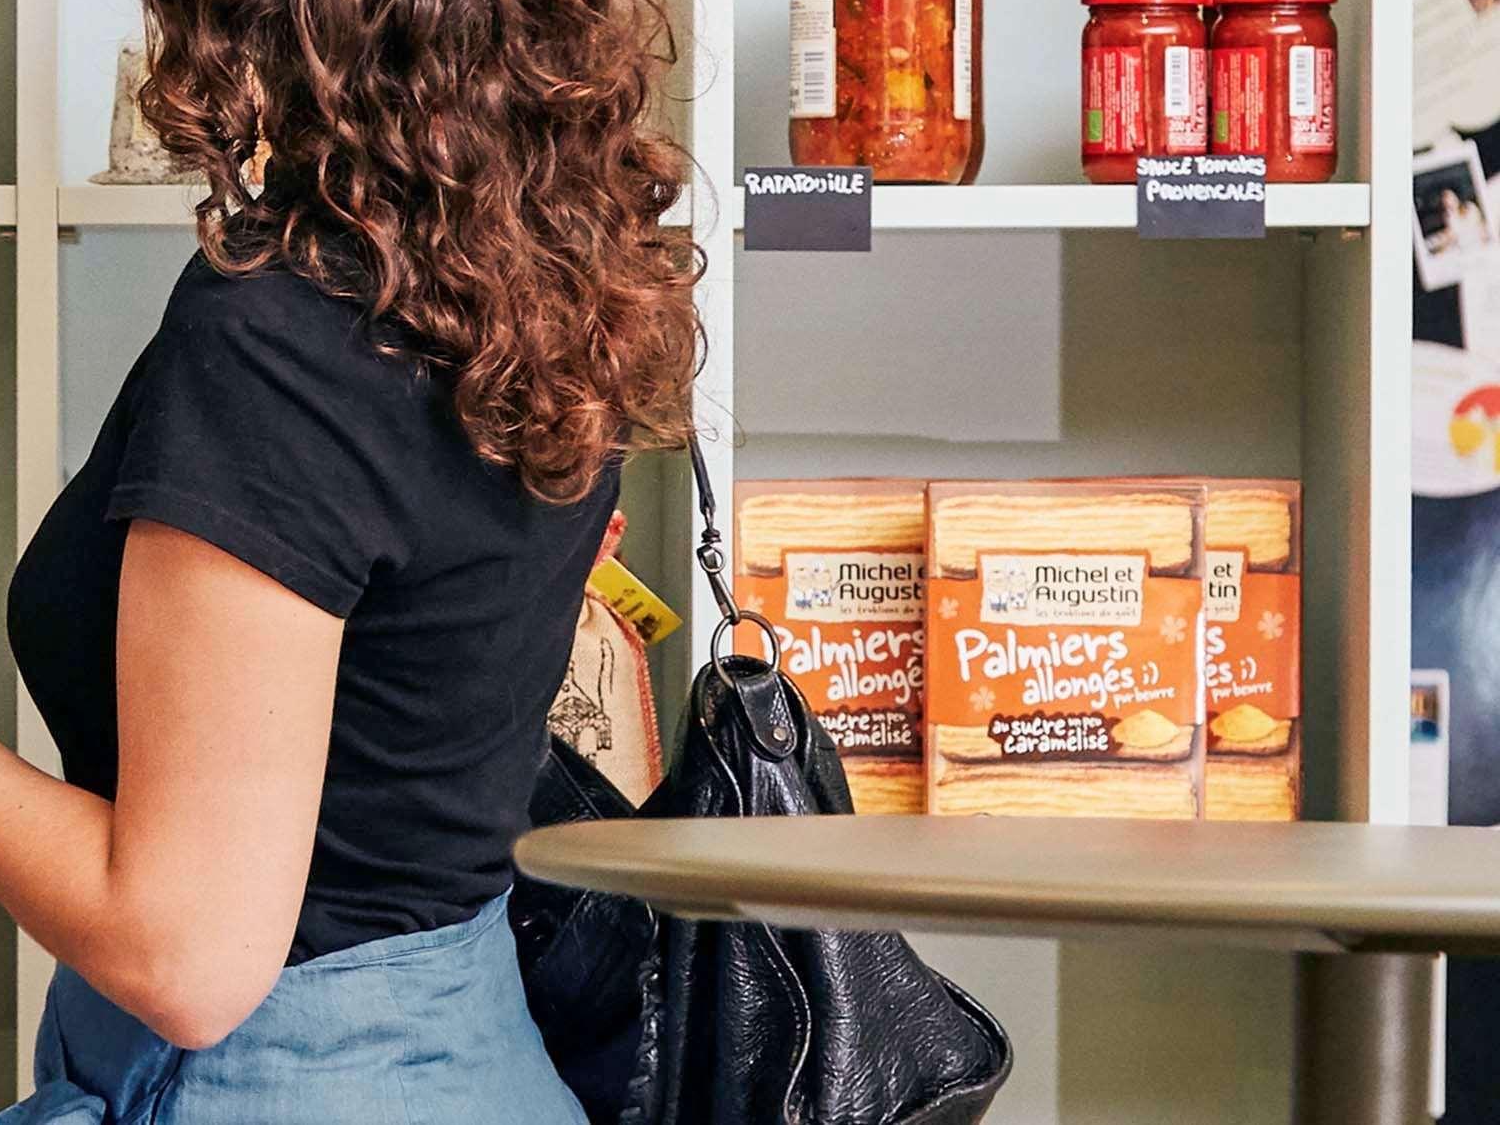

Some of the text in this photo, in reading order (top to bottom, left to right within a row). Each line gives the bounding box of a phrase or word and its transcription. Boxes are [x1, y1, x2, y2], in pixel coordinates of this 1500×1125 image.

[839, 562, 913, 581] Michel
[1034, 565, 1133, 583] Michel et
[1212, 562, 1233, 579] et
[839, 583, 924, 604] August
[1034, 585, 1140, 607] Augustin
[954, 628, 1129, 683] Palmiers
[827, 657, 924, 706] allongé
[1022, 659, 1136, 709] allongés
[832, 724, 913, 749] ramélisé
[991, 719, 1010, 734] au
[1010, 716, 1067, 737] sucre
[1003, 729, 1110, 755] caramélisé
